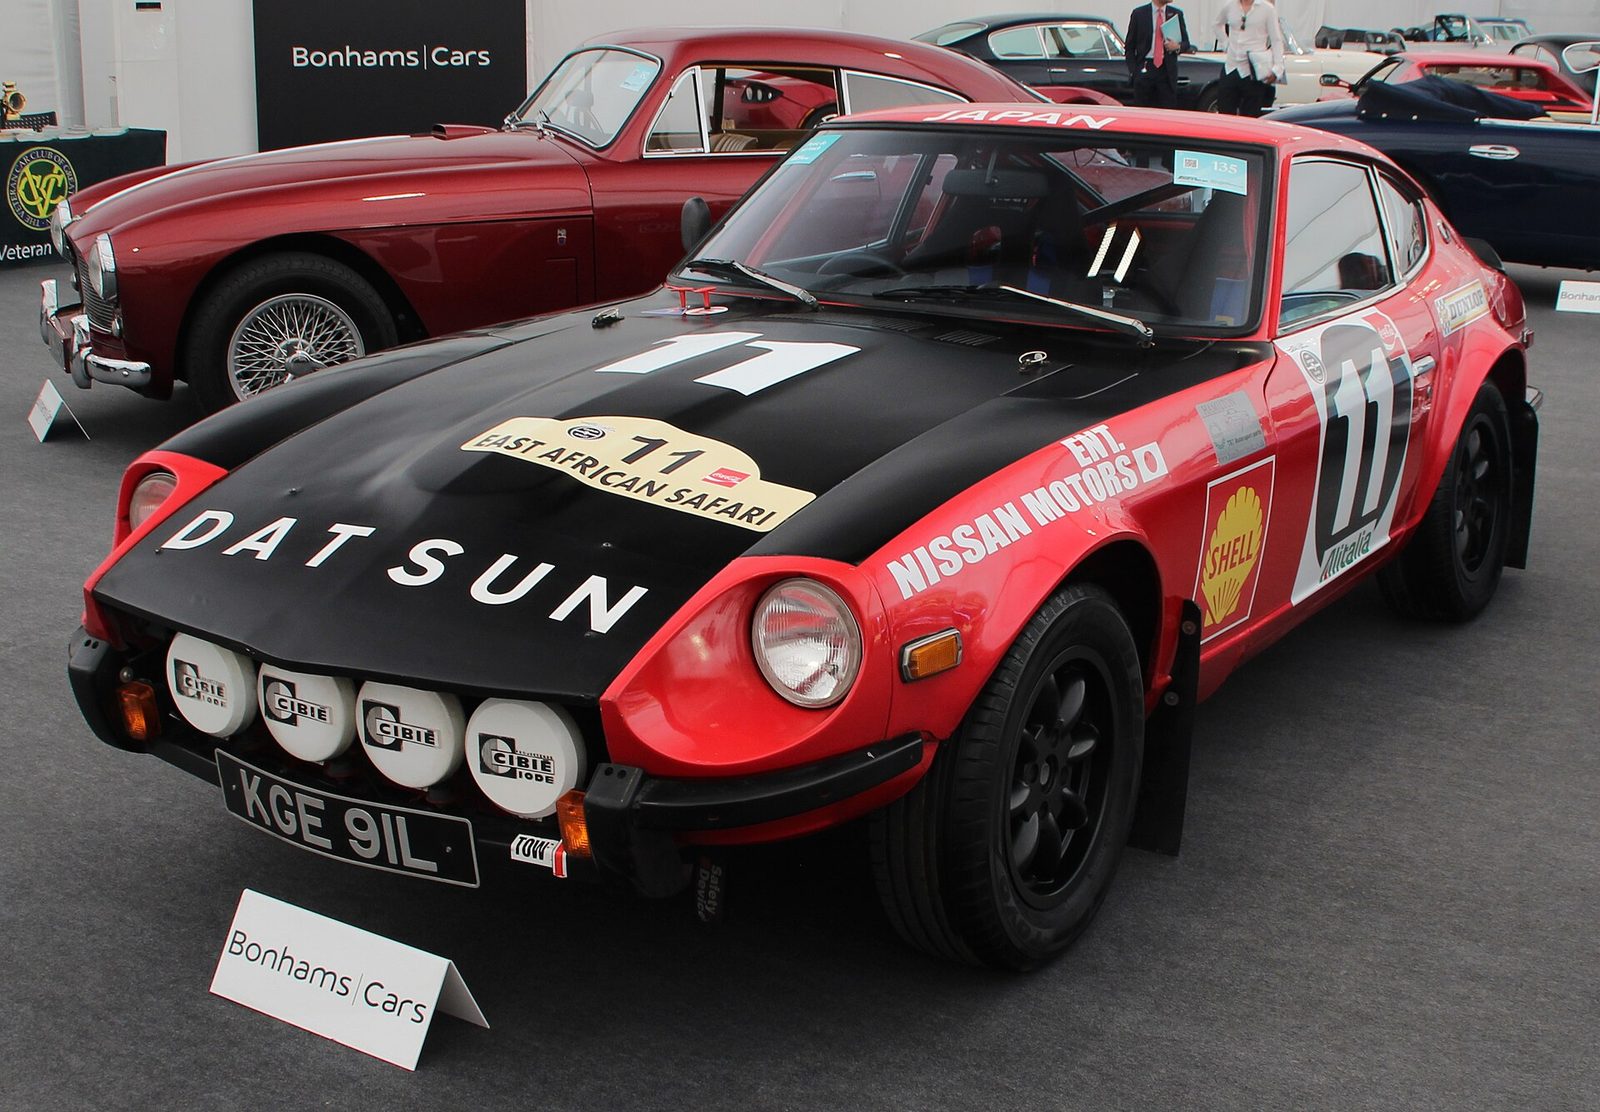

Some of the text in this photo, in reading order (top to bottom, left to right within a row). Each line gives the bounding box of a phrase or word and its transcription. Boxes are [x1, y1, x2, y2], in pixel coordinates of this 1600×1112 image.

[292, 45, 491, 67] Bonhams Cars
[922, 109, 1118, 130] JAPAN
[14, 155, 31, 173] CAR
[29, 150, 54, 160] CLUB
[53, 154, 66, 165] OF
[1213, 161, 1238, 174] 135
[9, 174, 27, 218] VETERAN
[24, 214, 41, 227] THE
[0, 243, 52, 261] Veteran
[1449, 289, 1484, 321] DUNLOP
[594, 331, 862, 397] 11
[620, 434, 706, 475] 11
[1060, 424, 1126, 468] ENT.
[1333, 346, 1395, 537] 11
[473, 433, 777, 526] EAST AFRICAN SAFARI
[886, 454, 1139, 601] NISSAN MOTORS
[160, 509, 649, 634] DATSUN
[1208, 530, 1253, 580] SHELL
[1319, 529, 1371, 583] Alitalia
[518, 770, 555, 785] IODE
[239, 768, 438, 872] KGE 91L
[515, 836, 550, 861] TOW
[708, 865, 722, 915] Safety
[228, 929, 427, 1024] Bonhams Cars
